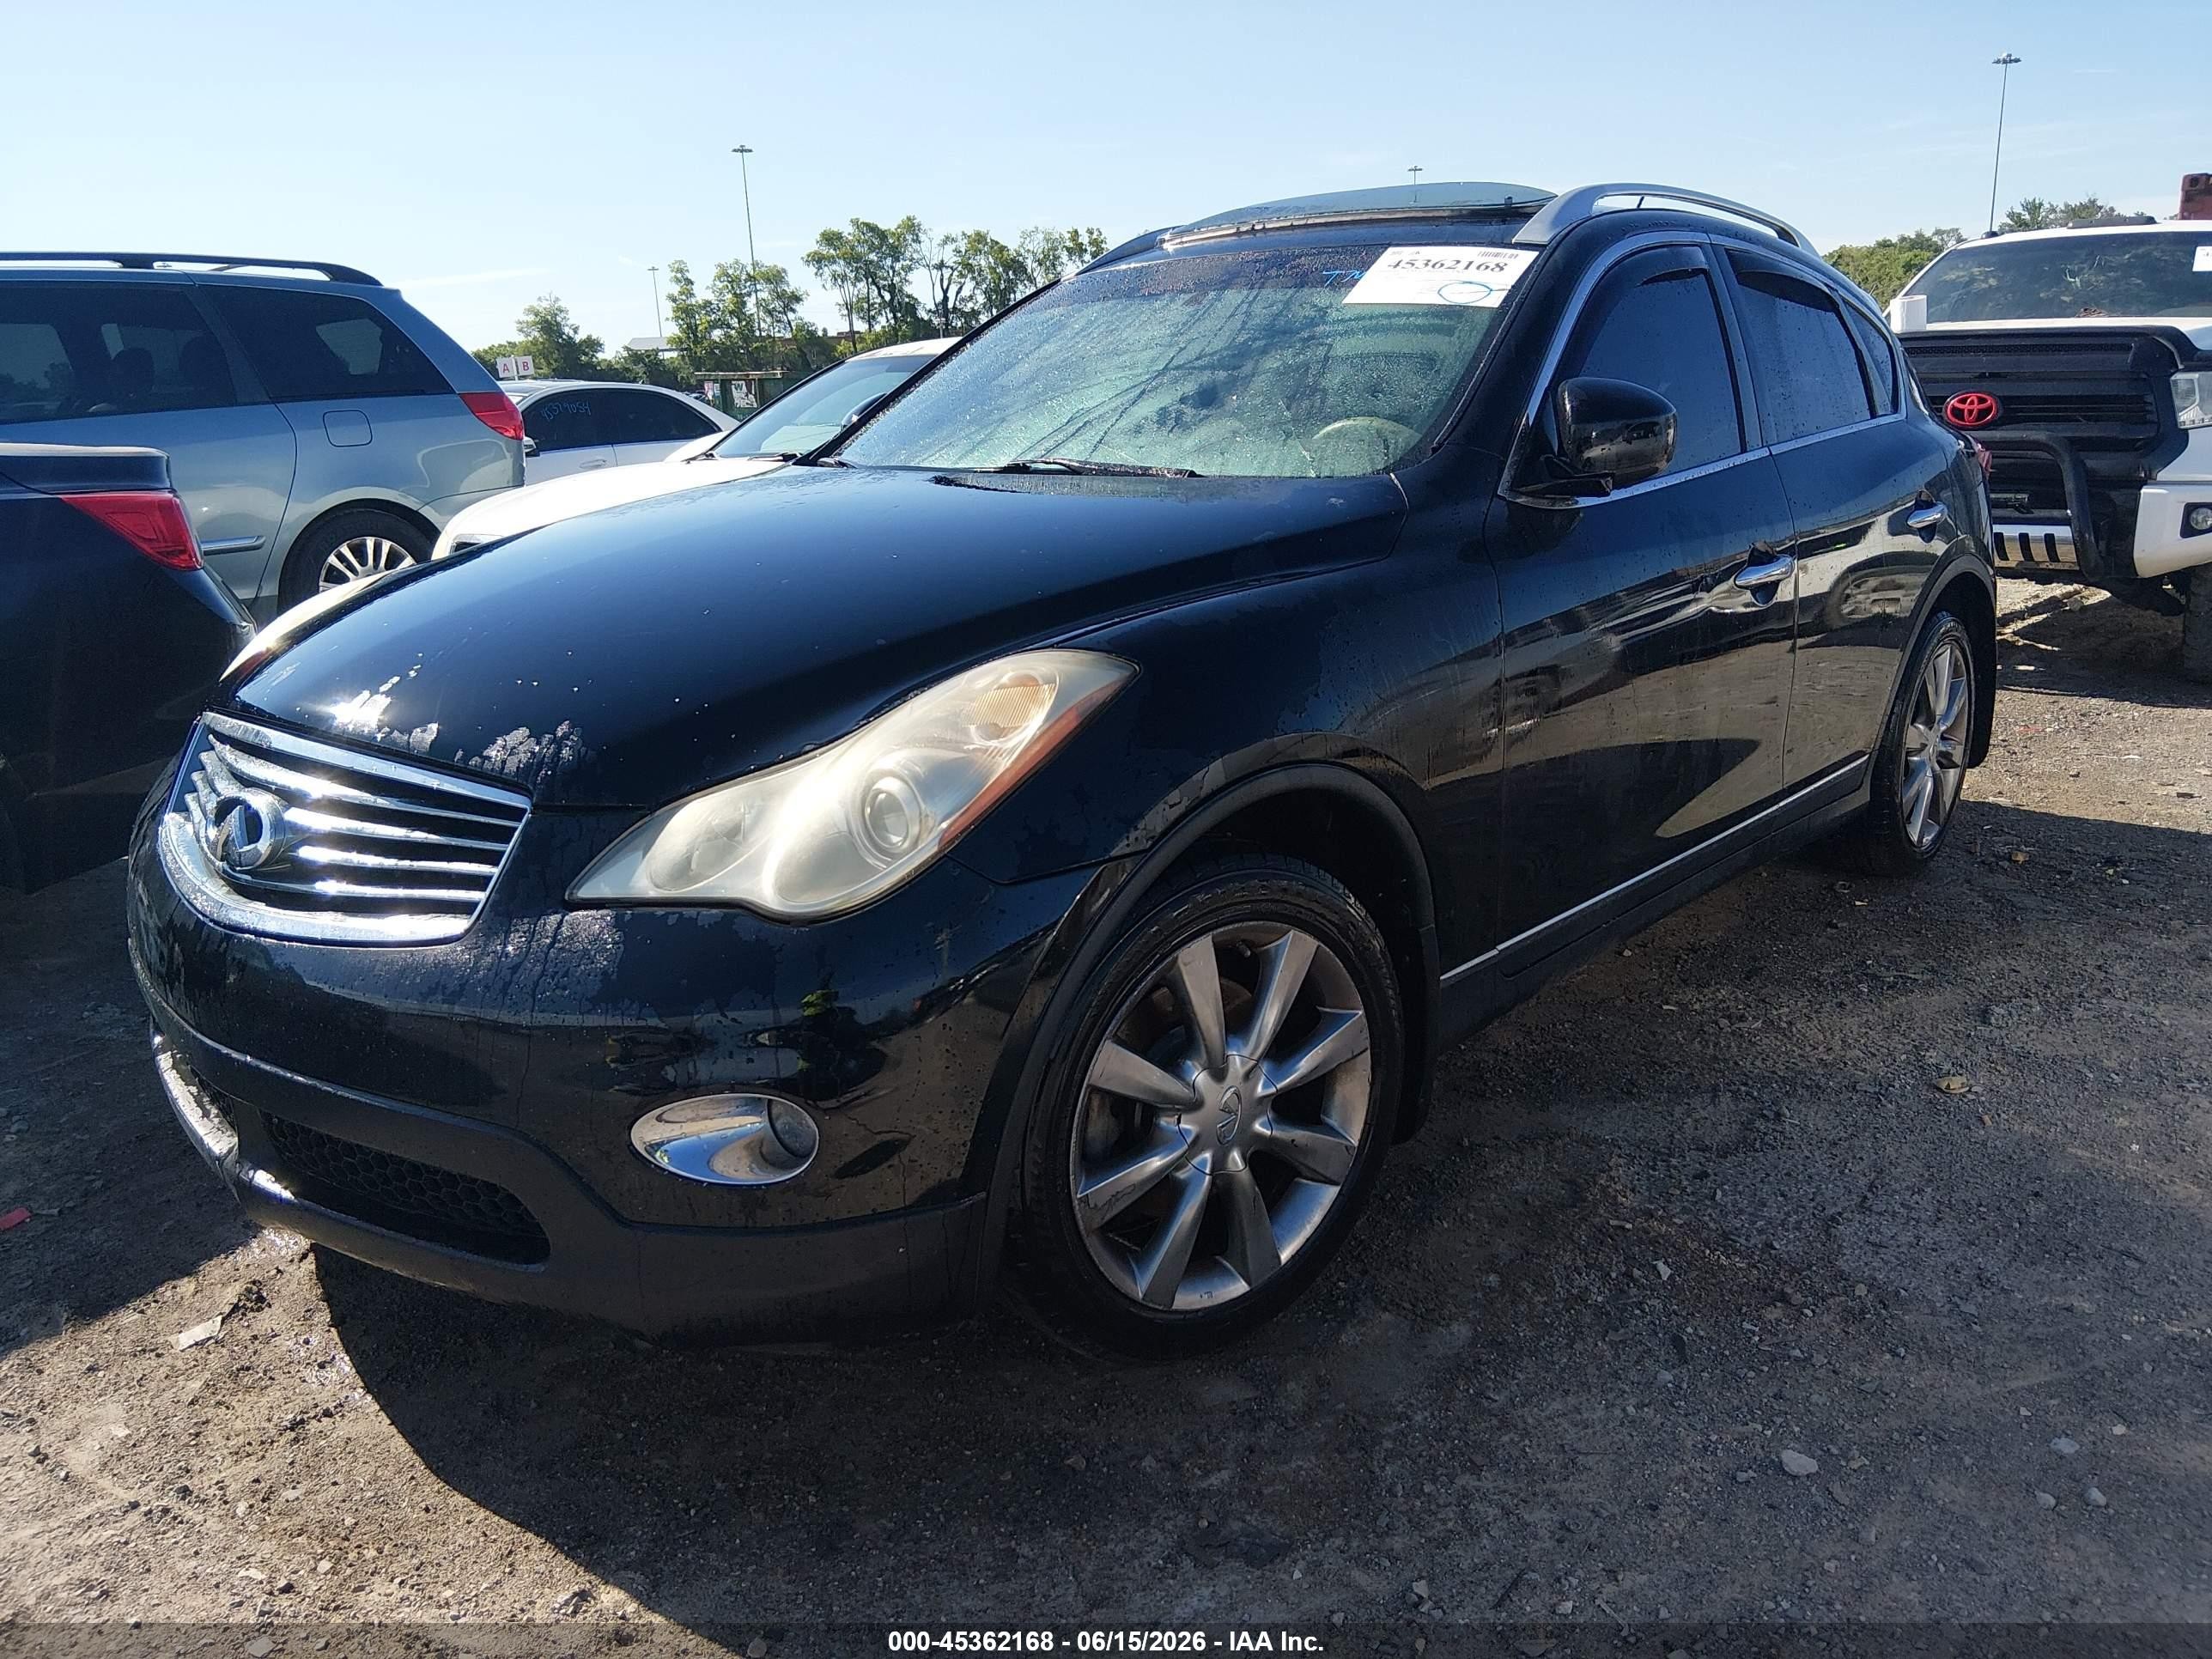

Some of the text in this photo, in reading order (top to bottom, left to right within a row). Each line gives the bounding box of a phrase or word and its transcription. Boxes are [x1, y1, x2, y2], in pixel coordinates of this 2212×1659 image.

[1388, 258, 1509, 273] 45362168
[502, 361, 530, 374] A B
